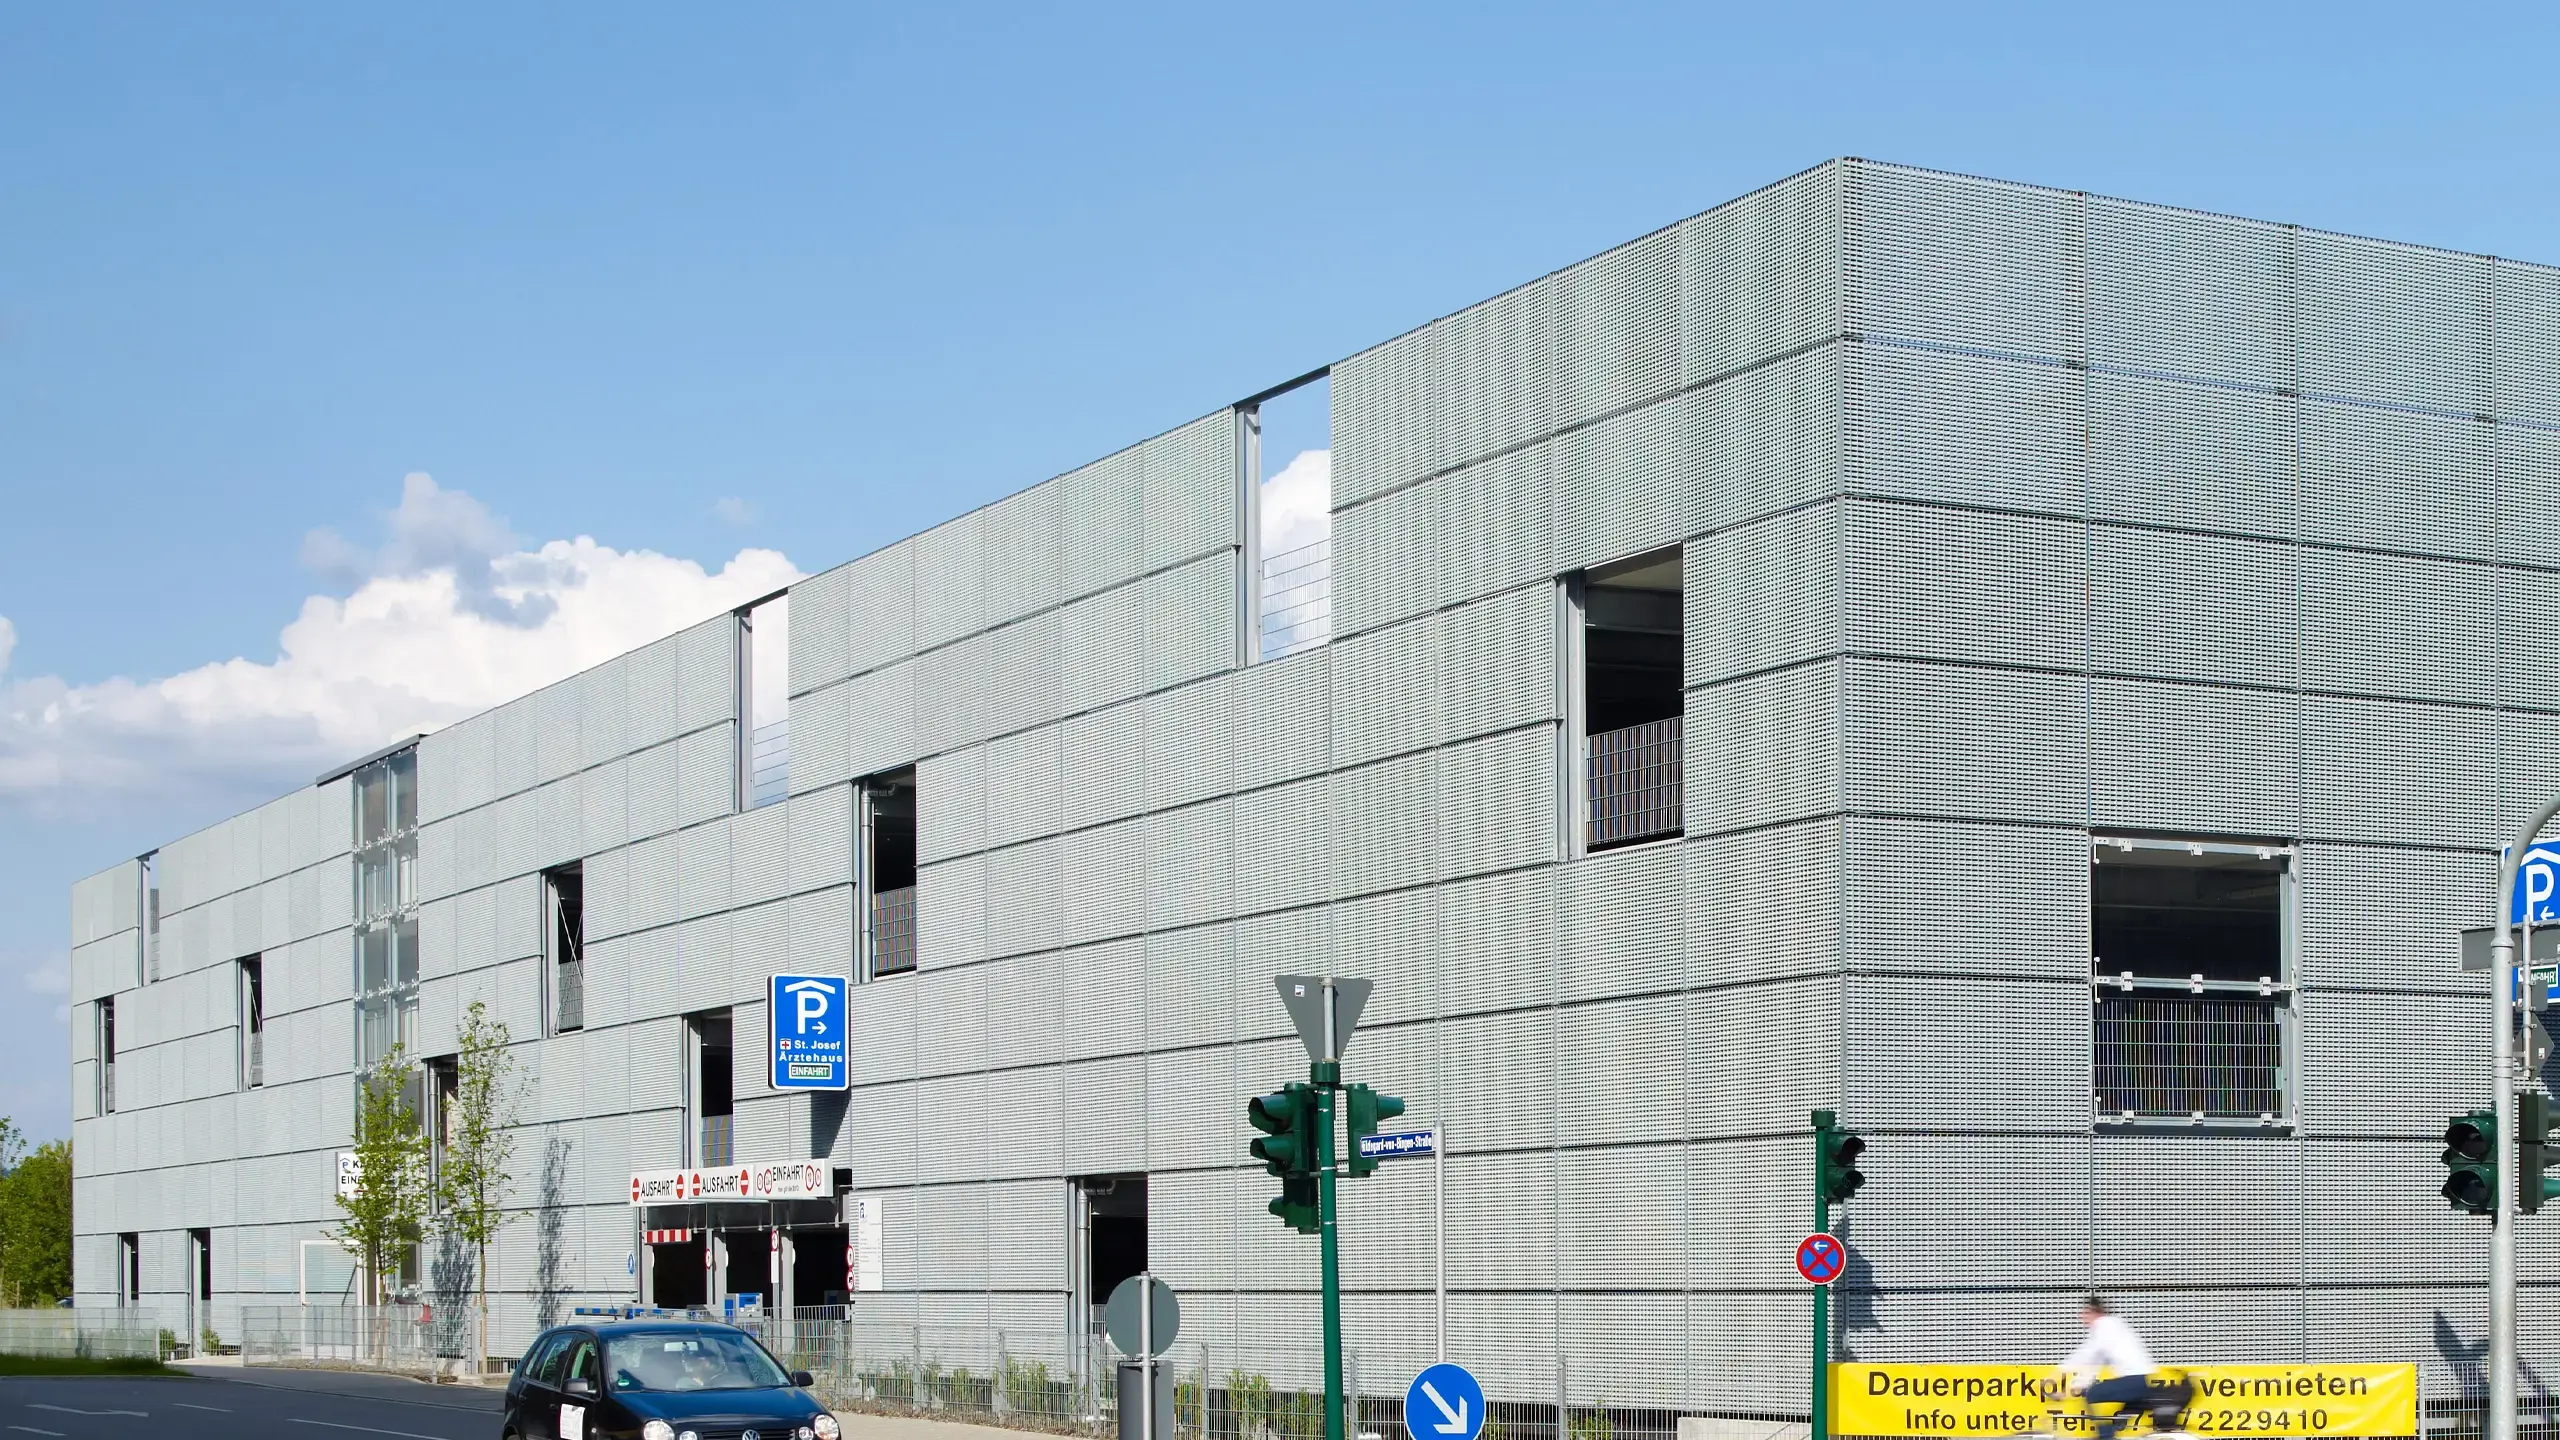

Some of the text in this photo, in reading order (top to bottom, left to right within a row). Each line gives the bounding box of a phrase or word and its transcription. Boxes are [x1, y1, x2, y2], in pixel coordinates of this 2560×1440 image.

[2526, 864, 2554, 922] P
[797, 990, 828, 1034] P
[794, 1039, 841, 1050] St. Josef
[779, 1050, 843, 1062] Ärztehaus
[791, 1066, 829, 1077] EINFAHRT
[772, 1164, 804, 1182] EINFAHRT
[640, 1179, 674, 1197] AUSFAHRT
[701, 1174, 739, 1193] AUSFAHRT
[2200, 1372, 2367, 1397] vermieten
[1906, 1408, 1956, 1430] Info
[1966, 1410, 2038, 1431] unter
[2047, 1409, 2095, 1431] Tel.
